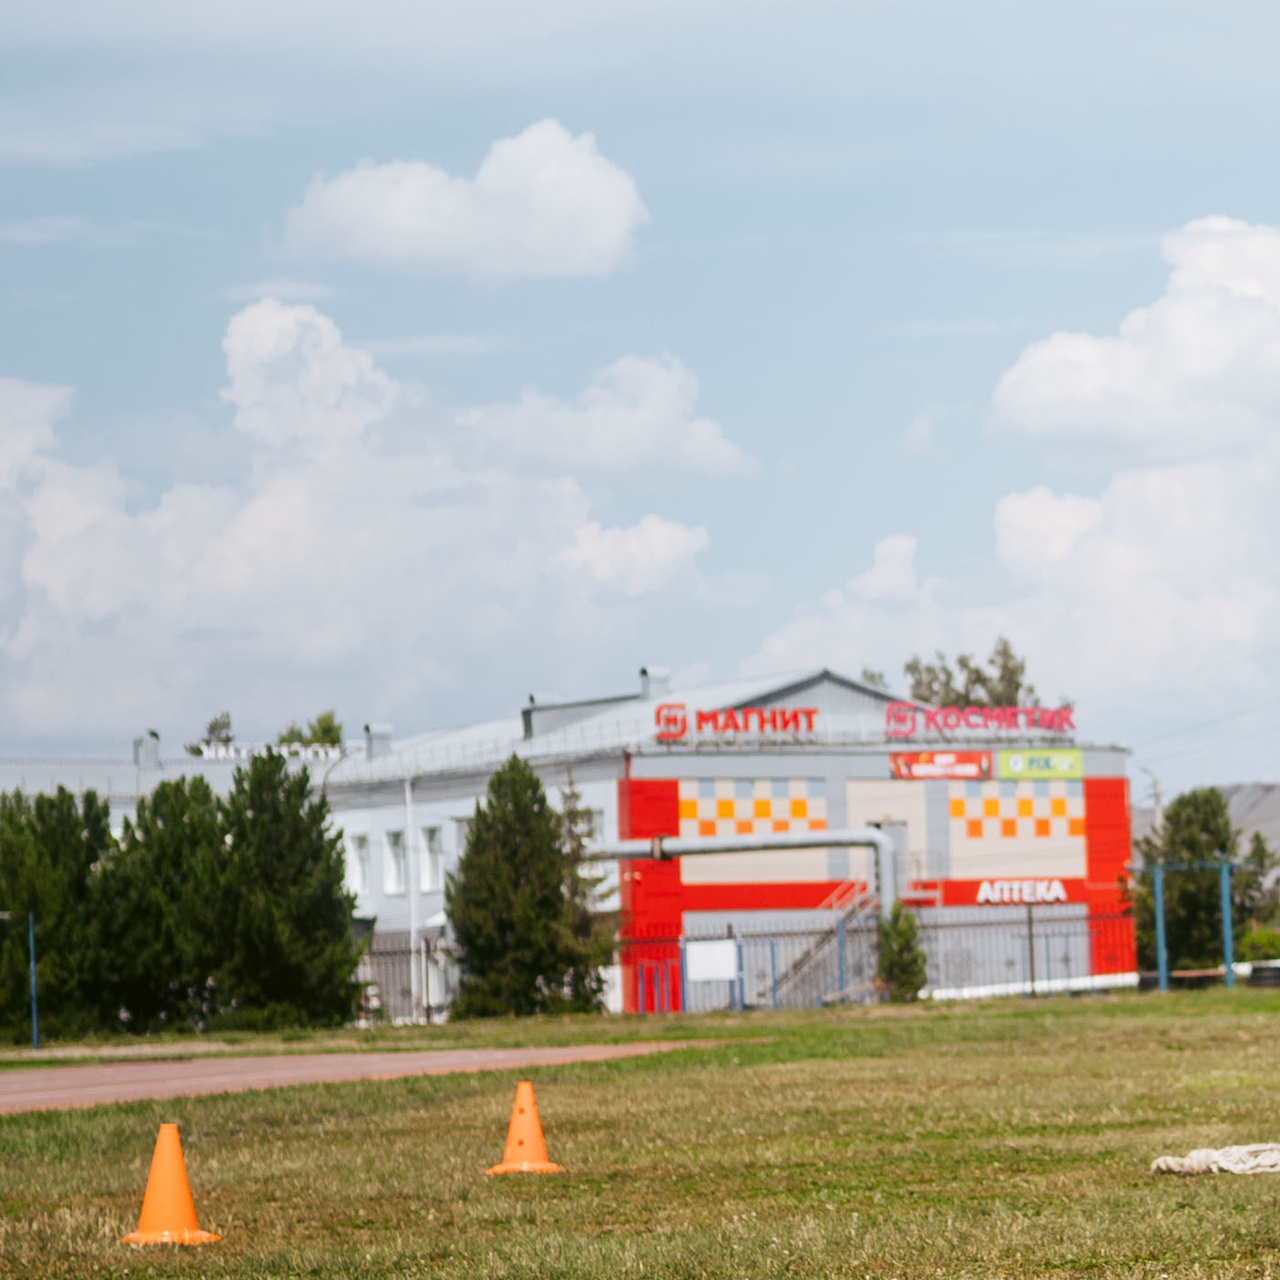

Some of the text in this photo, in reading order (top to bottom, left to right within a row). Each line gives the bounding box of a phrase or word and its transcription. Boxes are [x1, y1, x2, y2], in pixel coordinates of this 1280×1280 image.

[695, 706, 818, 733] МАГНИТ
[923, 705, 1076, 731] КОСМЕТИК
[977, 879, 1068, 904] АПТЕКА
